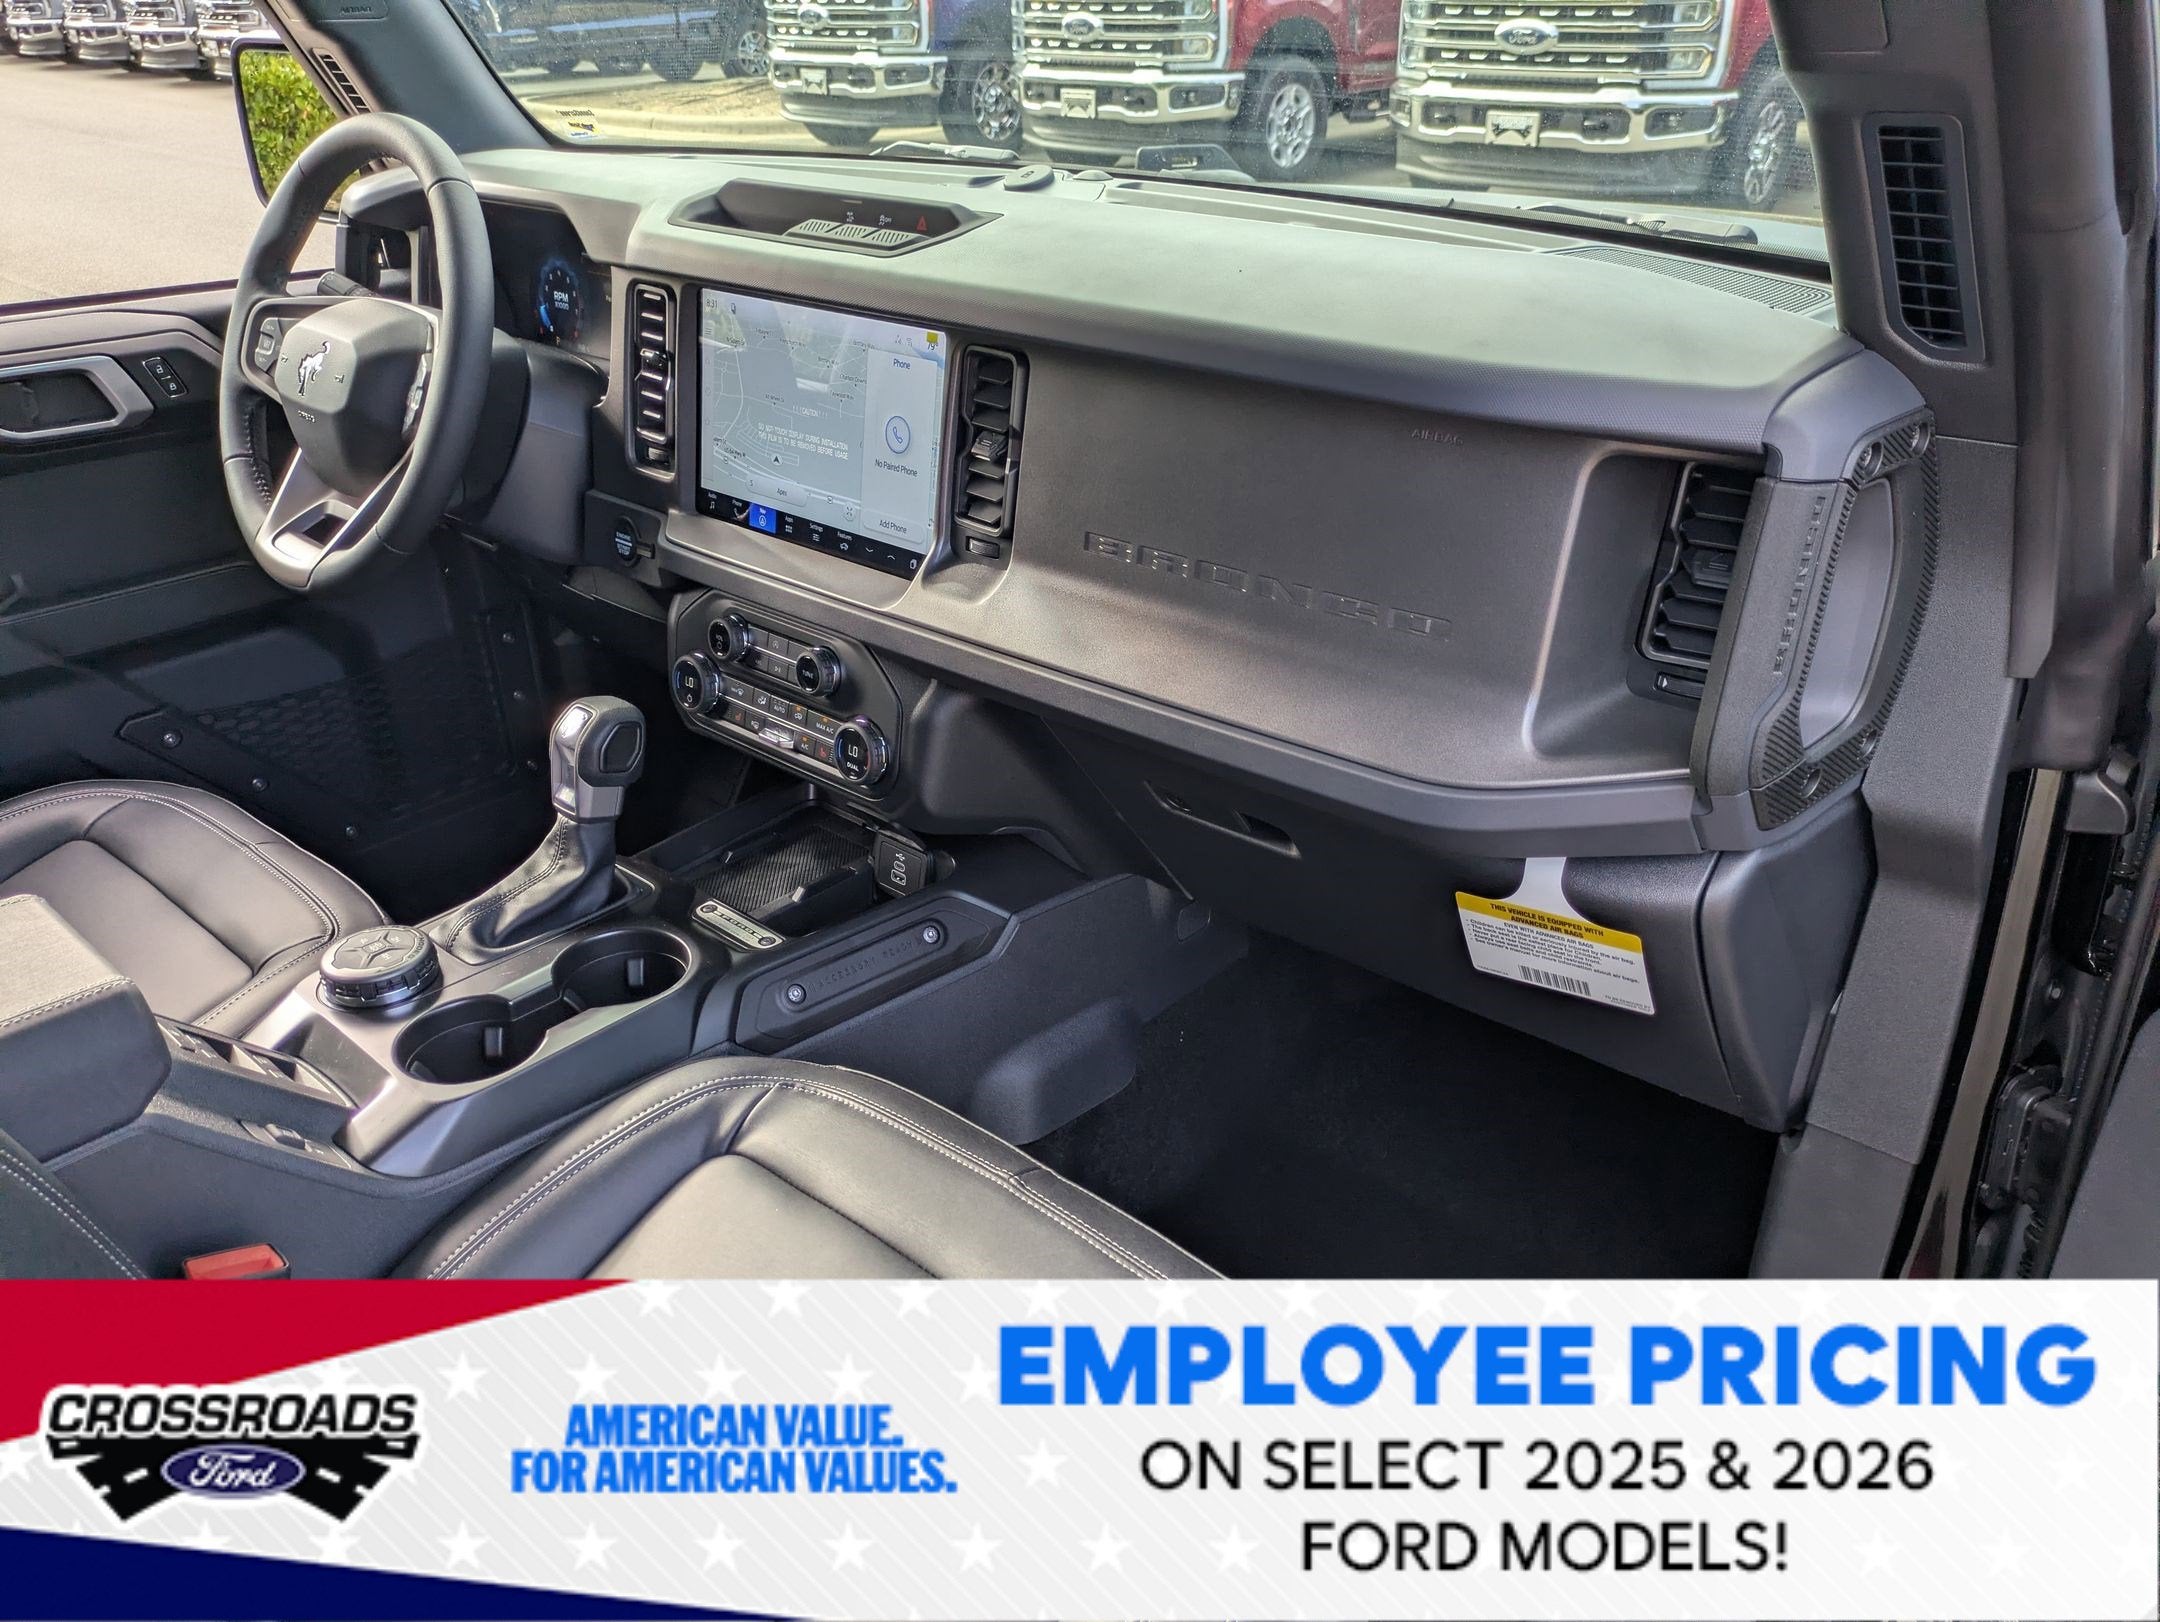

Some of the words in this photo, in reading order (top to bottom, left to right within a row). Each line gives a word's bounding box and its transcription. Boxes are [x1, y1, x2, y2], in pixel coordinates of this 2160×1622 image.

[553, 291, 569, 303] RPM
[893, 358, 910, 370] Phone
[817, 446, 833, 456] BEFORE
[834, 450, 848, 460] USAGE
[874, 458, 882, 468] No
[884, 461, 900, 472] Paired
[900, 465, 918, 477] Phone
[810, 522, 823, 533] Settings
[880, 520, 890, 528] Add
[891, 522, 907, 534] Phone
[1084, 531, 1452, 641] BRONCO
[774, 705, 786, 714] AUTO
[816, 722, 826, 730] MAX
[826, 726, 834, 734] A/C
[848, 744, 858, 758] LO
[846, 761, 859, 772] DUAL
[1490, 903, 1506, 912] THIS
[1507, 907, 1537, 919] VEHICLE
[1546, 918, 1582, 931] EQUIPPED
[1584, 926, 1604, 936] WITH
[1473, 928, 1488, 936] Never
[1510, 916, 1548, 930] ADVANCED
[1550, 925, 1562, 933] AIR
[1564, 929, 1584, 938] BAGS
[1470, 918, 1494, 928] Children
[1516, 929, 1531, 938] killed
[1540, 937, 1567, 948] seriously
[1568, 943, 1590, 954] injured
[1621, 958, 1636, 966] bag.
[1504, 922, 1518, 930] EVEN
[1520, 926, 1534, 934] WITH
[1536, 930, 1566, 942] ADVANCED
[1578, 941, 1594, 949] BAGS
